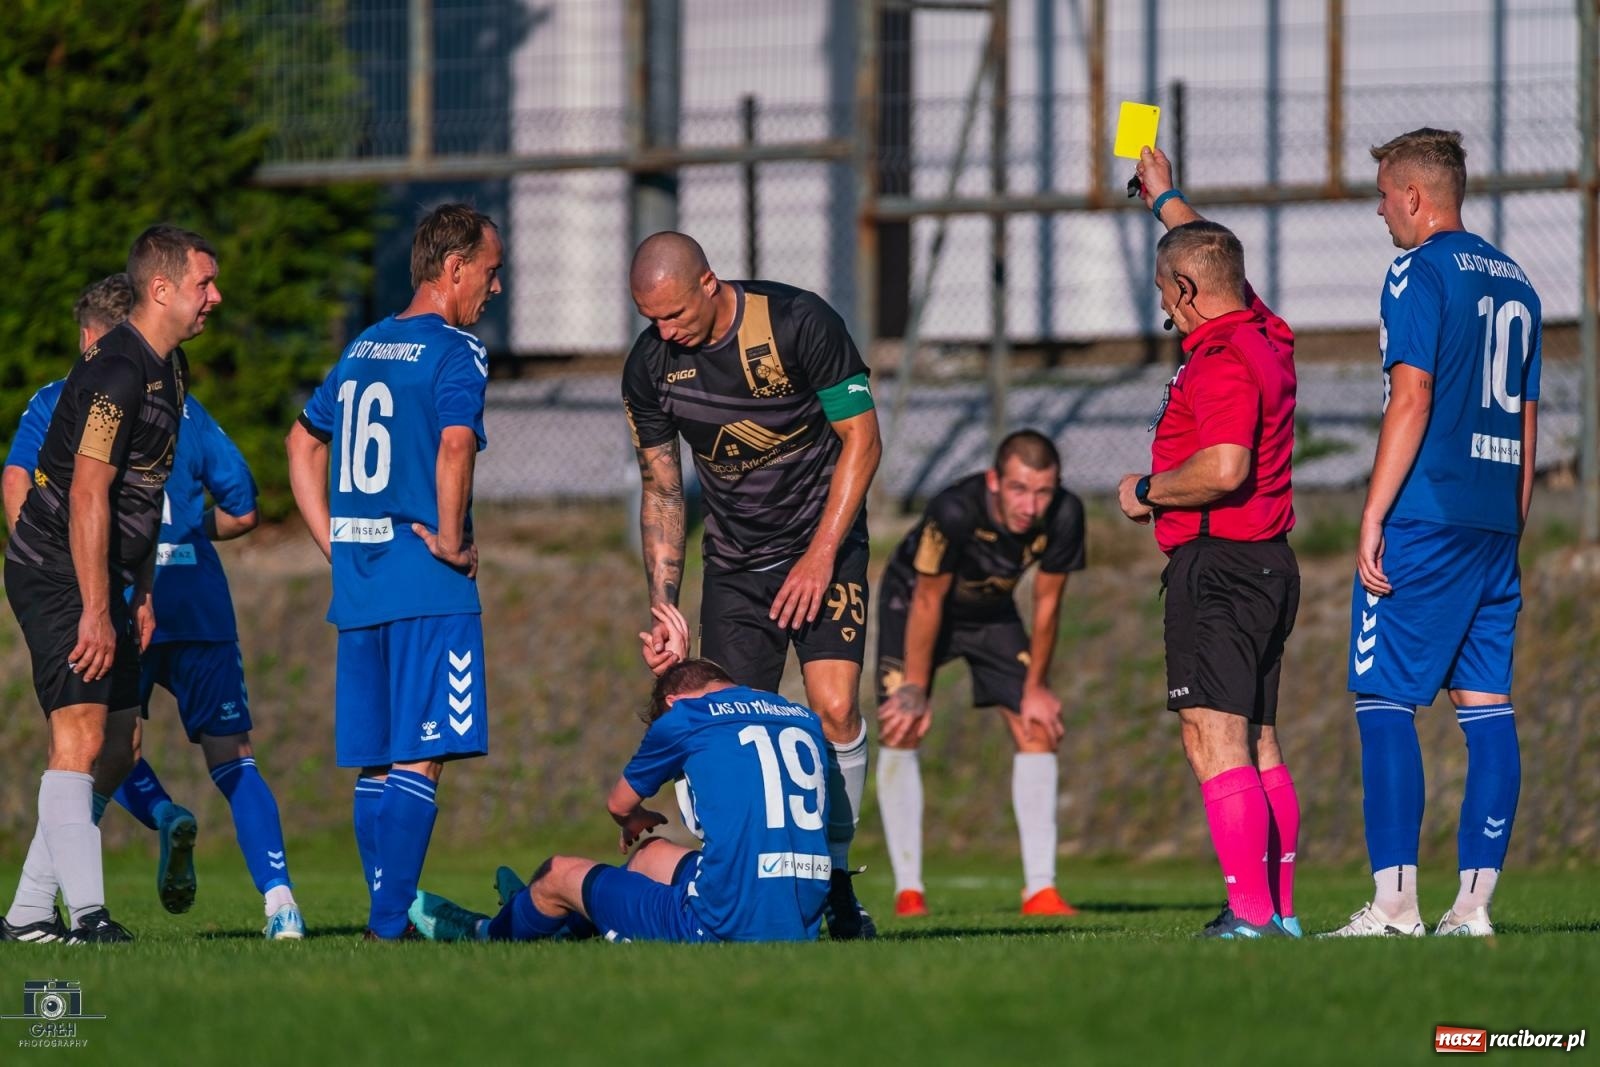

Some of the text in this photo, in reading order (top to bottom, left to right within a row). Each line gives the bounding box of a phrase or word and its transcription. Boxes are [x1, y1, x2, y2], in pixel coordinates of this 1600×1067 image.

[1453, 252, 1475, 271] LKS
[1472, 254, 1486, 273] 07
[357, 340, 374, 359] 07
[368, 342, 426, 362] MARKOWICE
[1477, 295, 1532, 414] 10
[337, 380, 394, 495] 16
[826, 582, 865, 625] 95
[708, 701, 735, 716] LKS
[733, 701, 751, 714] 07
[737, 725, 826, 831] 19
